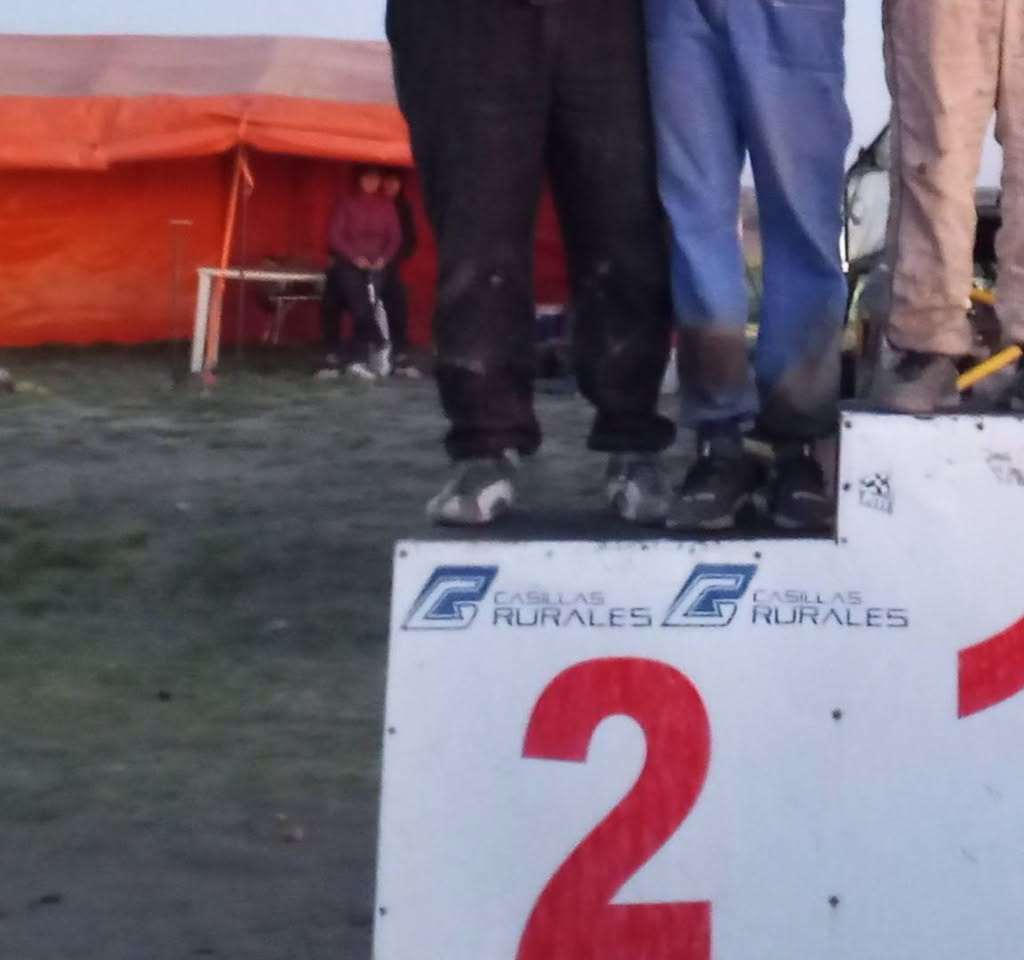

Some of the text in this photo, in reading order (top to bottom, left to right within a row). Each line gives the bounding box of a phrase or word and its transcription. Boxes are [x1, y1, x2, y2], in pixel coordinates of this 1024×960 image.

[493, 591, 605, 606] CASILLAS
[752, 589, 862, 605] CASILLAS
[492, 607, 653, 628] RURALES
[751, 605, 909, 628] RURALES
[515, 656, 712, 960] 2
